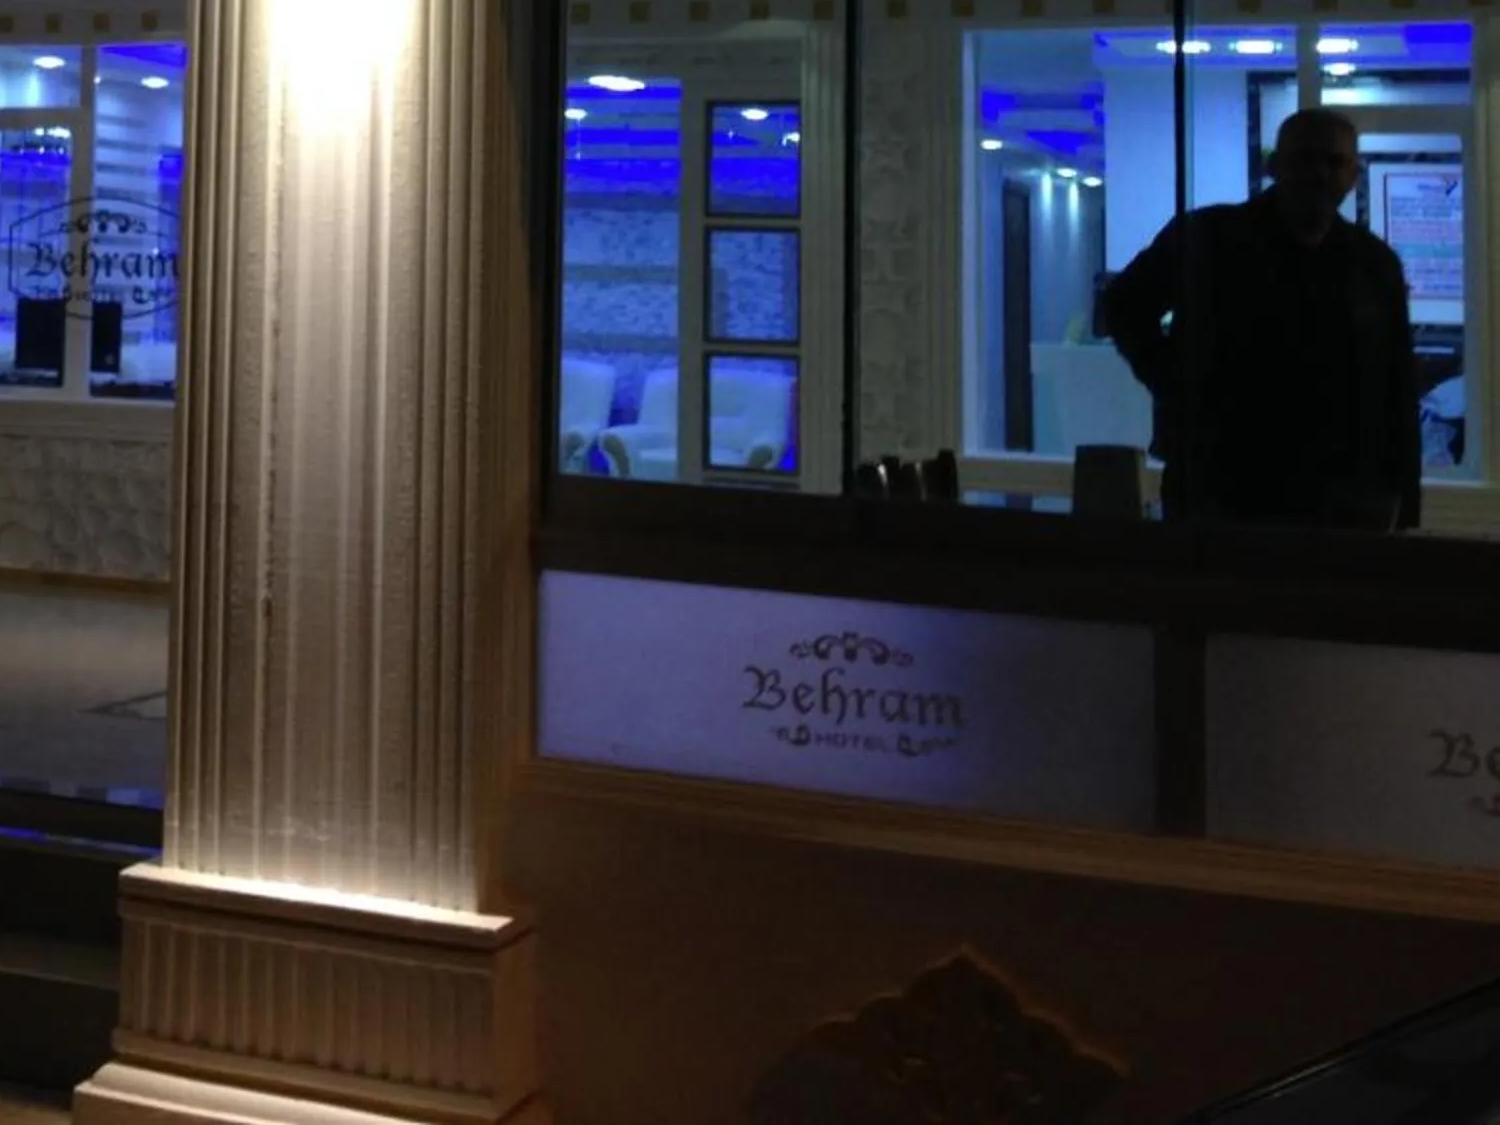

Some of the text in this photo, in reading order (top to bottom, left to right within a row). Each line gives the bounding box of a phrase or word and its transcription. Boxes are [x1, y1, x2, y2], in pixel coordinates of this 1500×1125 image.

[26, 238, 180, 284] Behram
[742, 666, 965, 725] Behram
[814, 731, 886, 752] HOTEL
